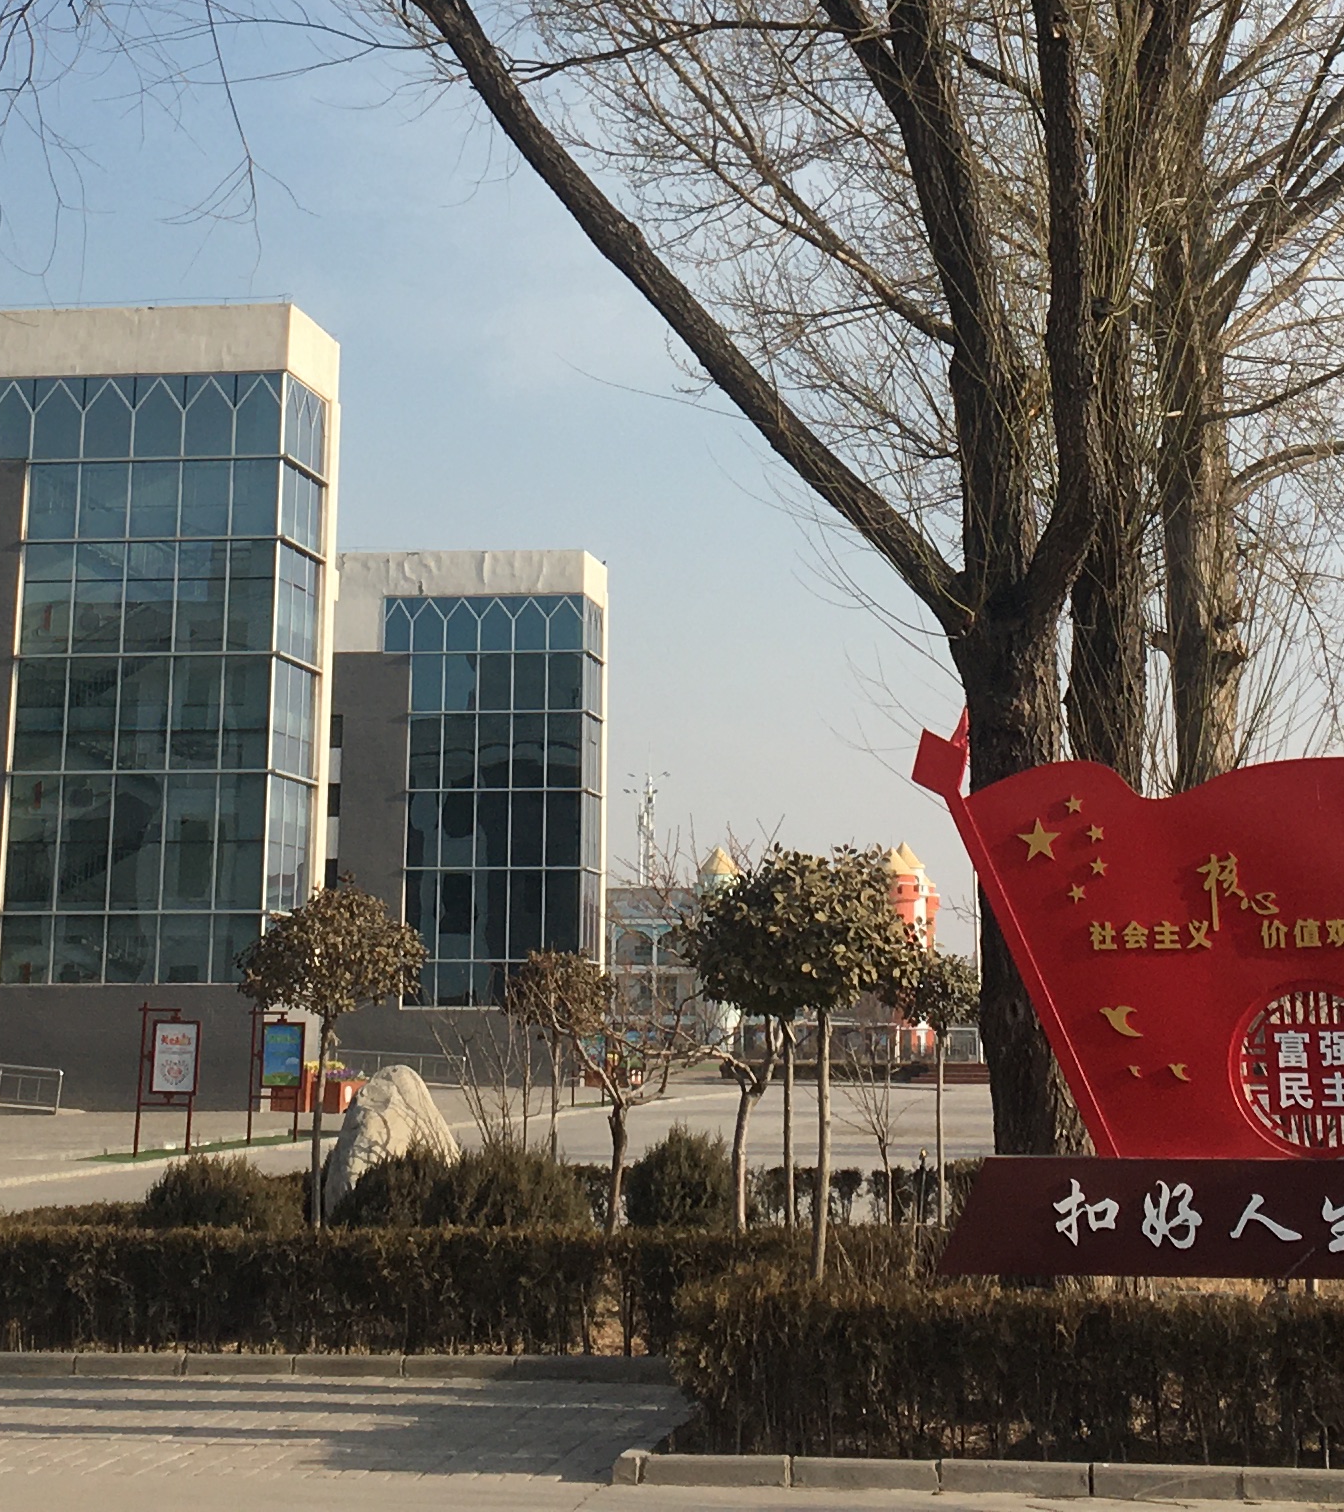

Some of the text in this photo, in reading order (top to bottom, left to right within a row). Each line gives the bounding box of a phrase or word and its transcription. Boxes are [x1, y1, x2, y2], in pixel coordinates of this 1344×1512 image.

[1089, 919, 1213, 951] 社会主义
[1196, 851, 1280, 932] 核心
